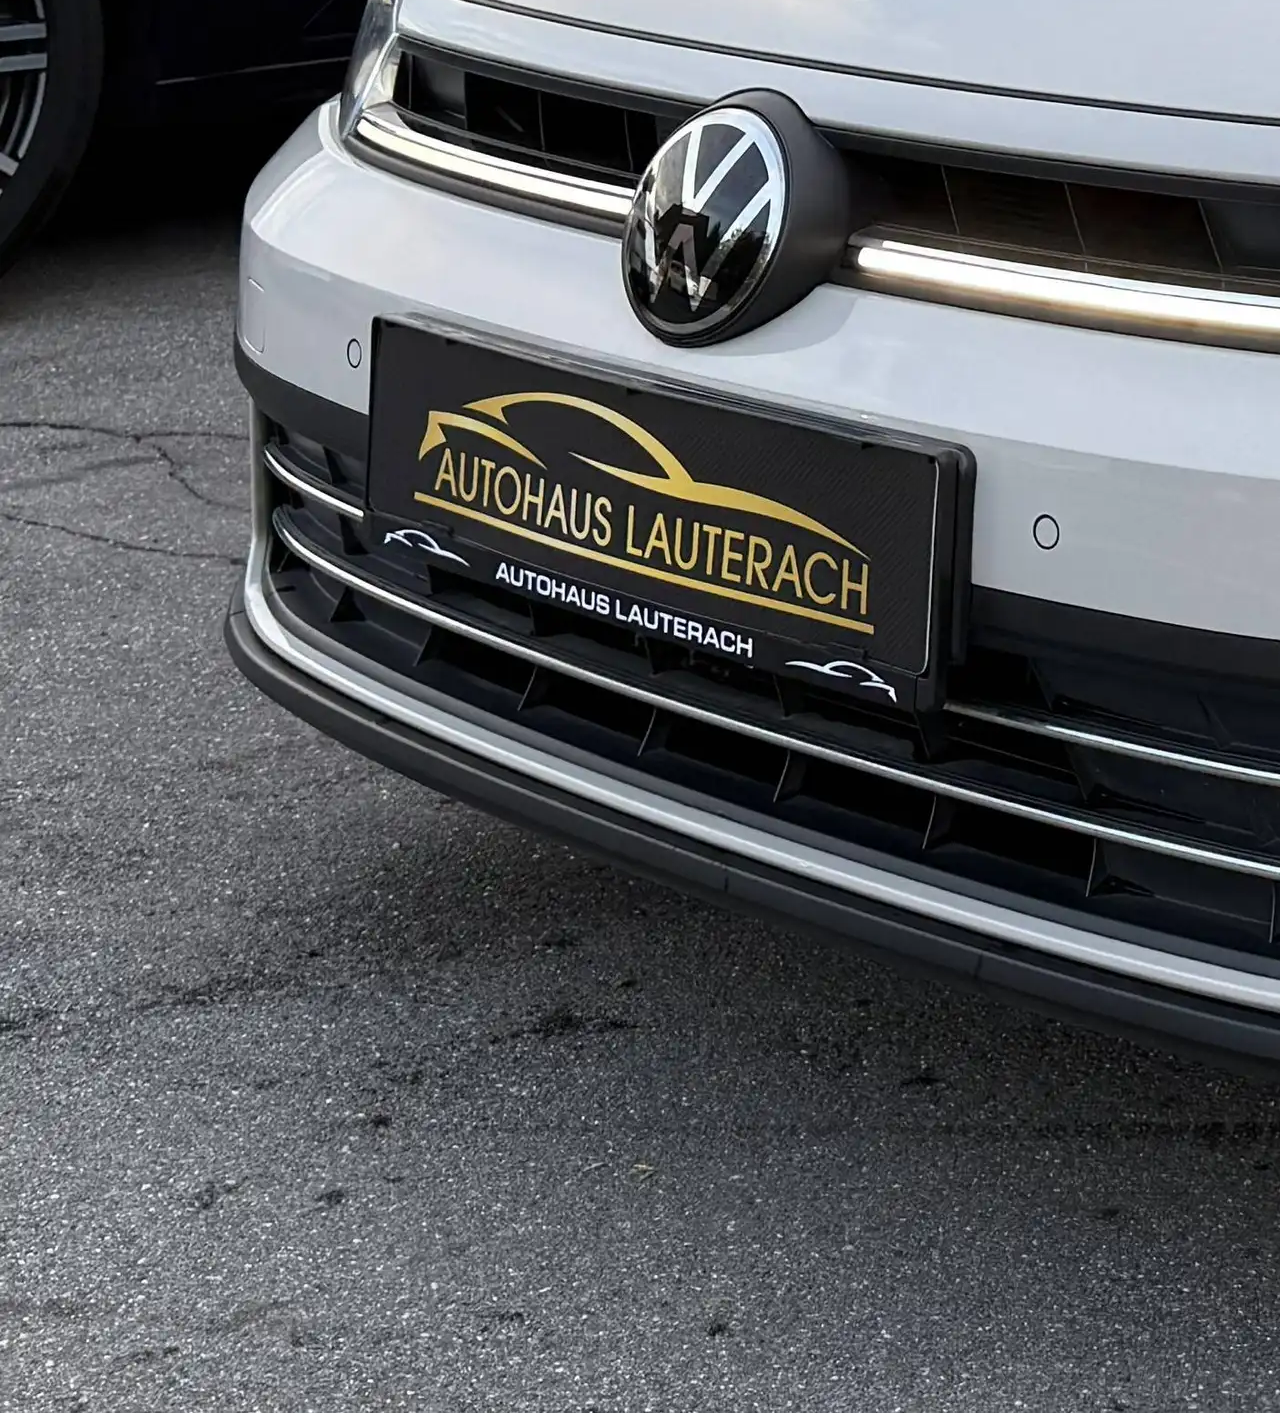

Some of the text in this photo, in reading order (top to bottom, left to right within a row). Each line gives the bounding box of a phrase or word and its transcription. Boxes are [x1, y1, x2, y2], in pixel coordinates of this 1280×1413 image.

[434, 446, 870, 617] AUTOHAUS LAUTERACH
[494, 562, 754, 659] AUTOHAUS LAUTERACH
